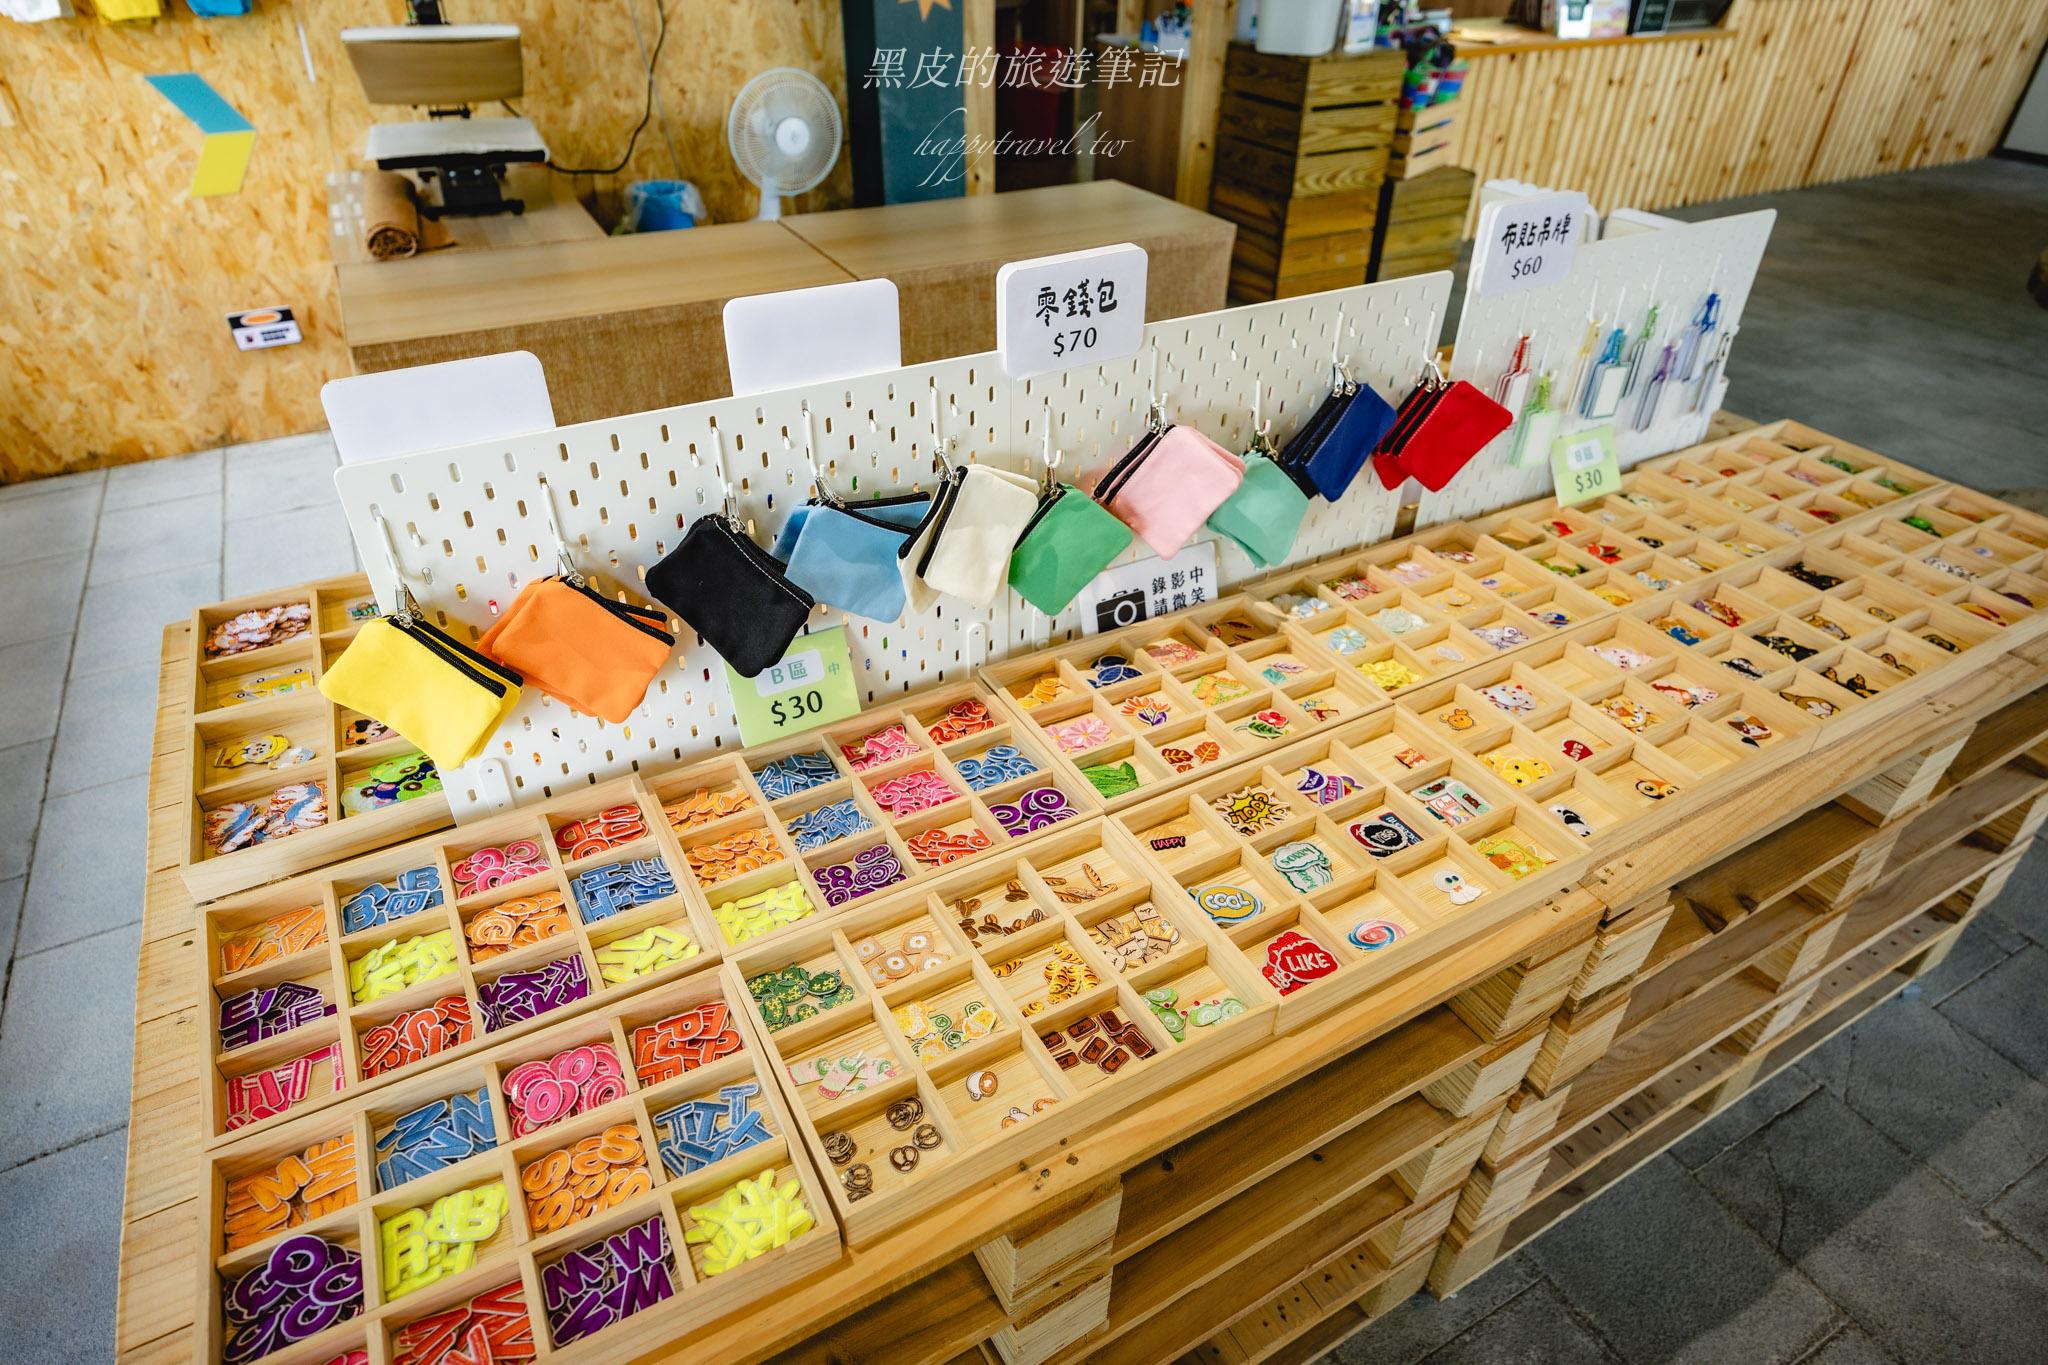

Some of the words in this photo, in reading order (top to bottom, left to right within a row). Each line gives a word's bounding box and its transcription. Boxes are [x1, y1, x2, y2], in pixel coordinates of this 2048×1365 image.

[1511, 255, 1543, 280] $60
[1035, 277, 1118, 327] 零錢包
[1052, 326, 1098, 358] $70
[1575, 468, 1602, 493] $30
[1151, 565, 1204, 596] 錄影中
[770, 690, 824, 727] $30
[1152, 835, 1186, 850] HAPPY
[1280, 845, 1316, 866] SORRY
[342, 894, 379, 935] B
[1203, 891, 1252, 911] COOL
[1284, 951, 1331, 973] LIKE
[220, 988, 259, 1031] E
[719, 1083, 761, 1128] T
[598, 1123, 641, 1165] S
[259, 1233, 330, 1288] Q
